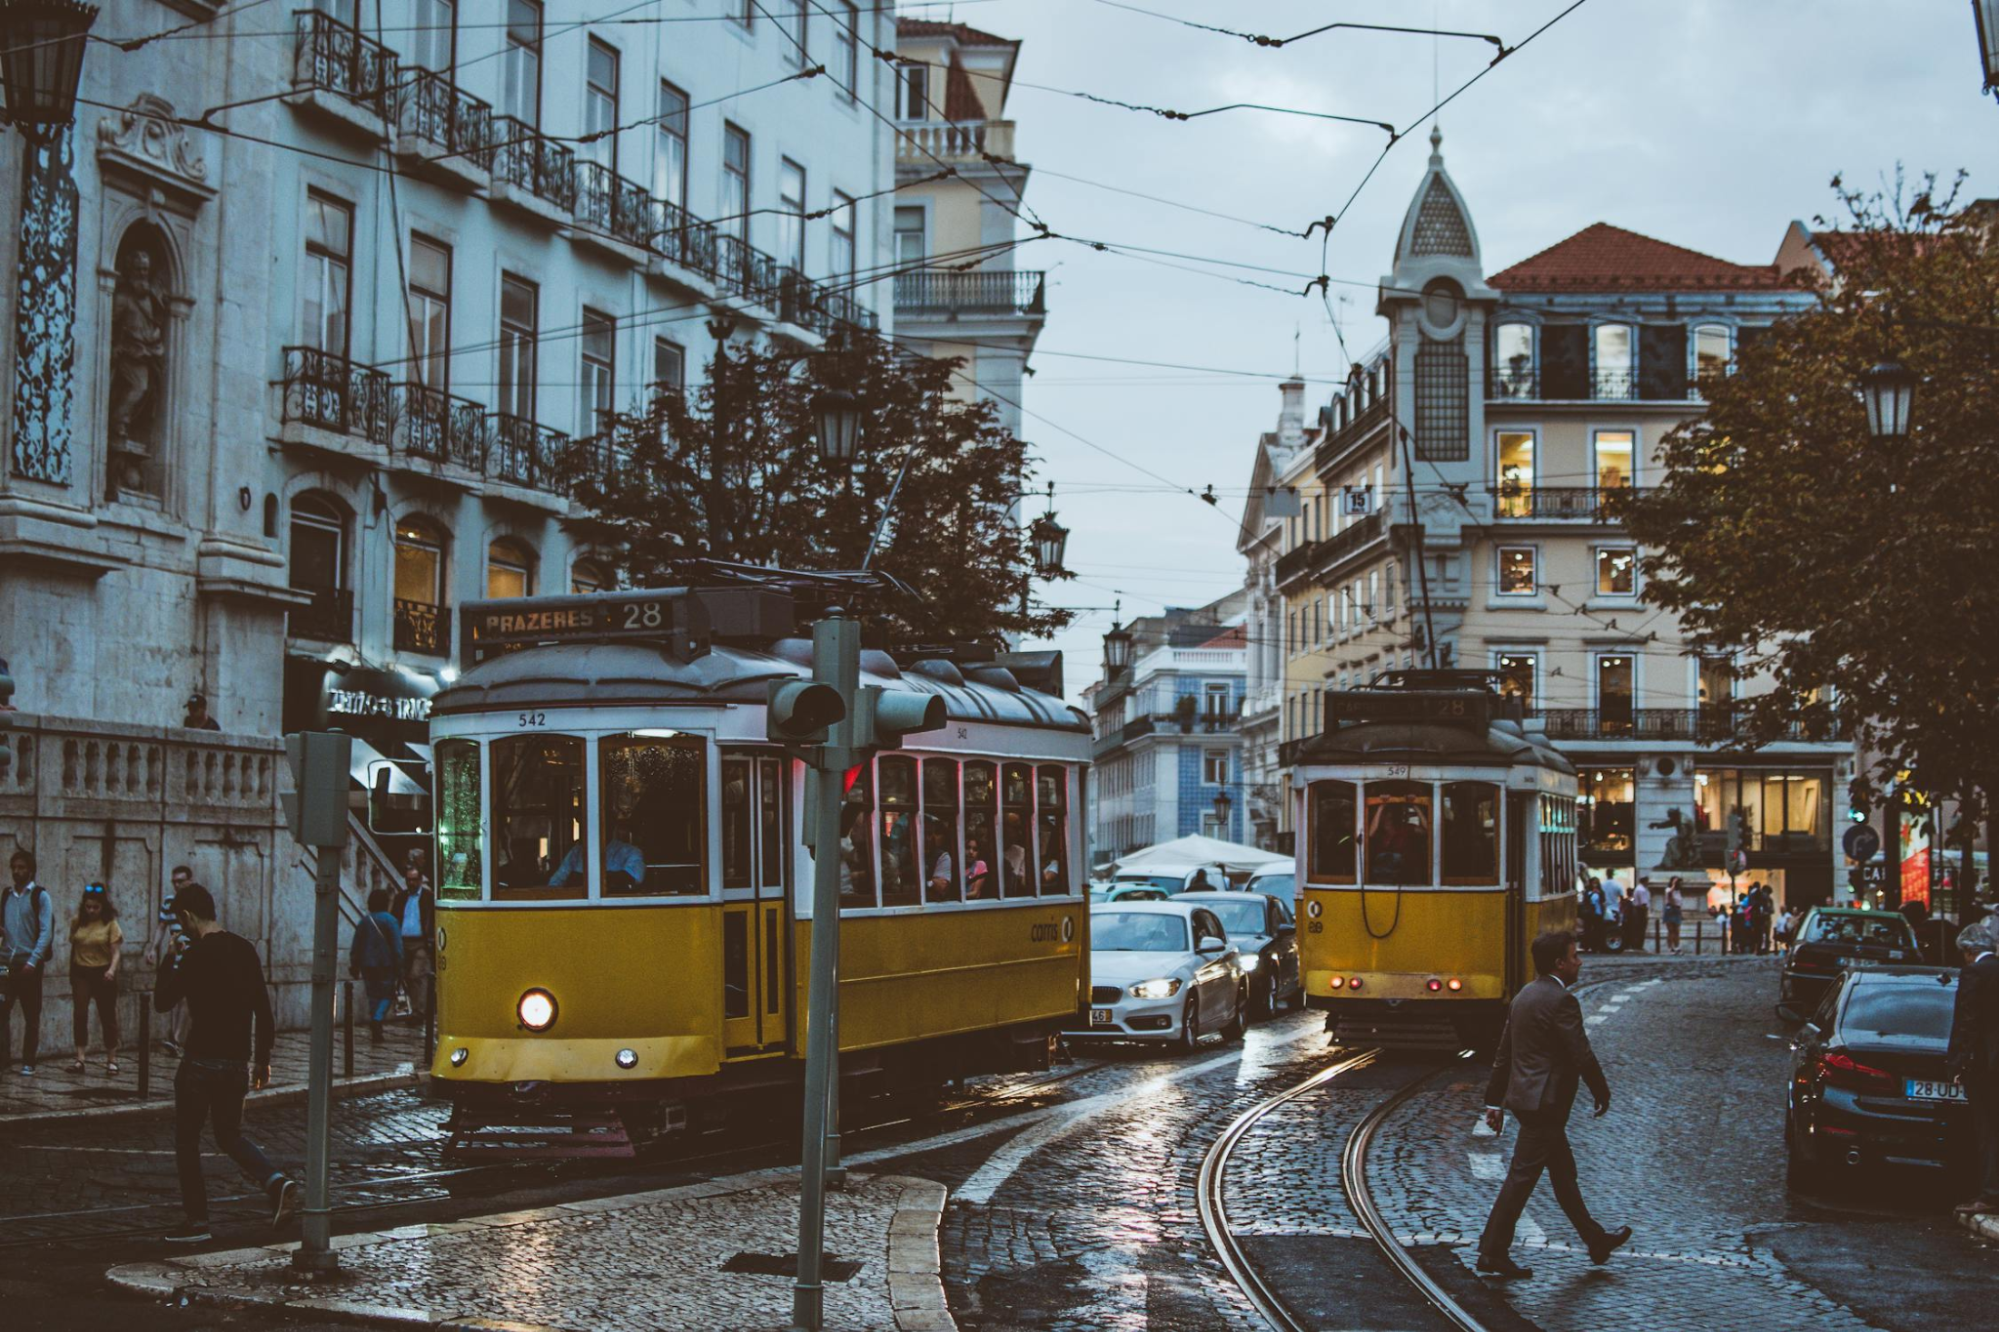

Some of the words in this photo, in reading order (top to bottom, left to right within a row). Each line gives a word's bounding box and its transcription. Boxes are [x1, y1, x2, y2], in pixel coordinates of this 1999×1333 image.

[1350, 493, 1366, 507] 15
[486, 609, 594, 634] PRAZERES
[623, 602, 662, 630] 28
[1438, 699, 1466, 717] 28
[518, 712, 547, 728] 542
[1387, 766, 1407, 776] 549
